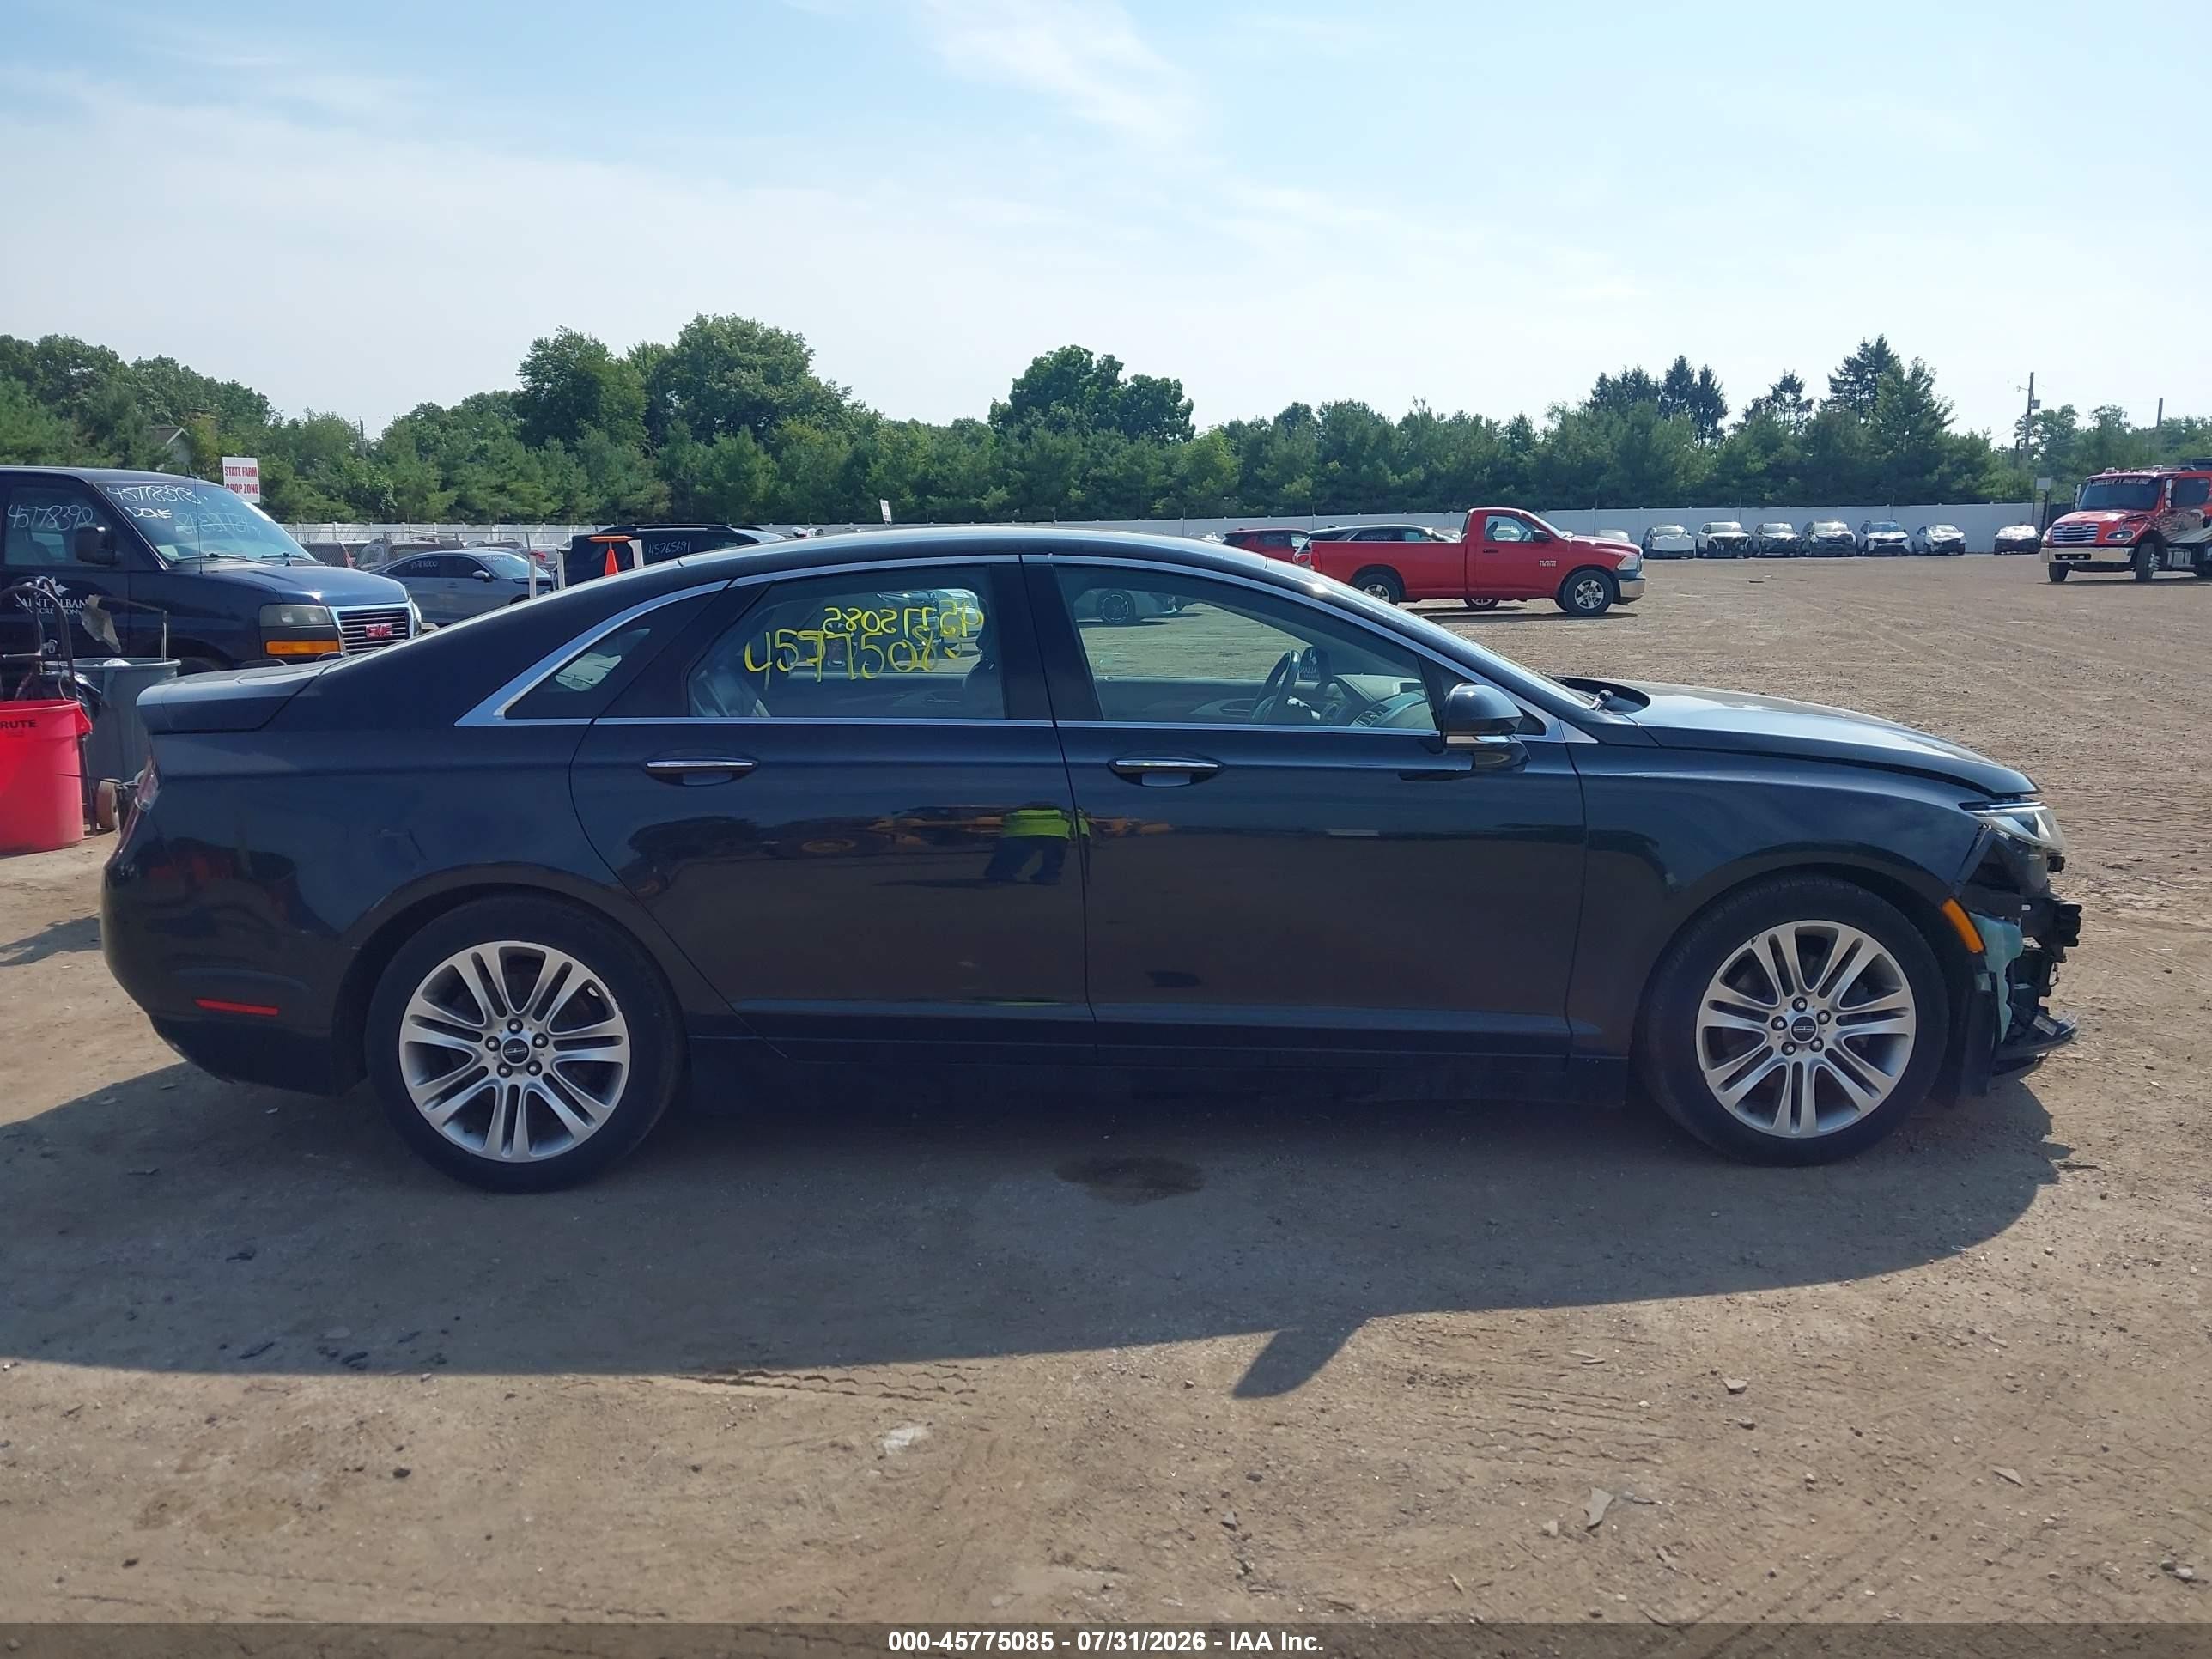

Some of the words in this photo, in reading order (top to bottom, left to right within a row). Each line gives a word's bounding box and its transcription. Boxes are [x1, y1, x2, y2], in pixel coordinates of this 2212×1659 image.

[225, 466, 241, 477] STATE
[242, 467, 258, 477] FARM
[244, 483, 258, 495] ZONE
[125, 506, 173, 520] DONE
[648, 541, 690, 556] 45765691
[15, 598, 50, 608] AINT
[365, 623, 392, 637] GMC
[744, 624, 963, 691] 45775085
